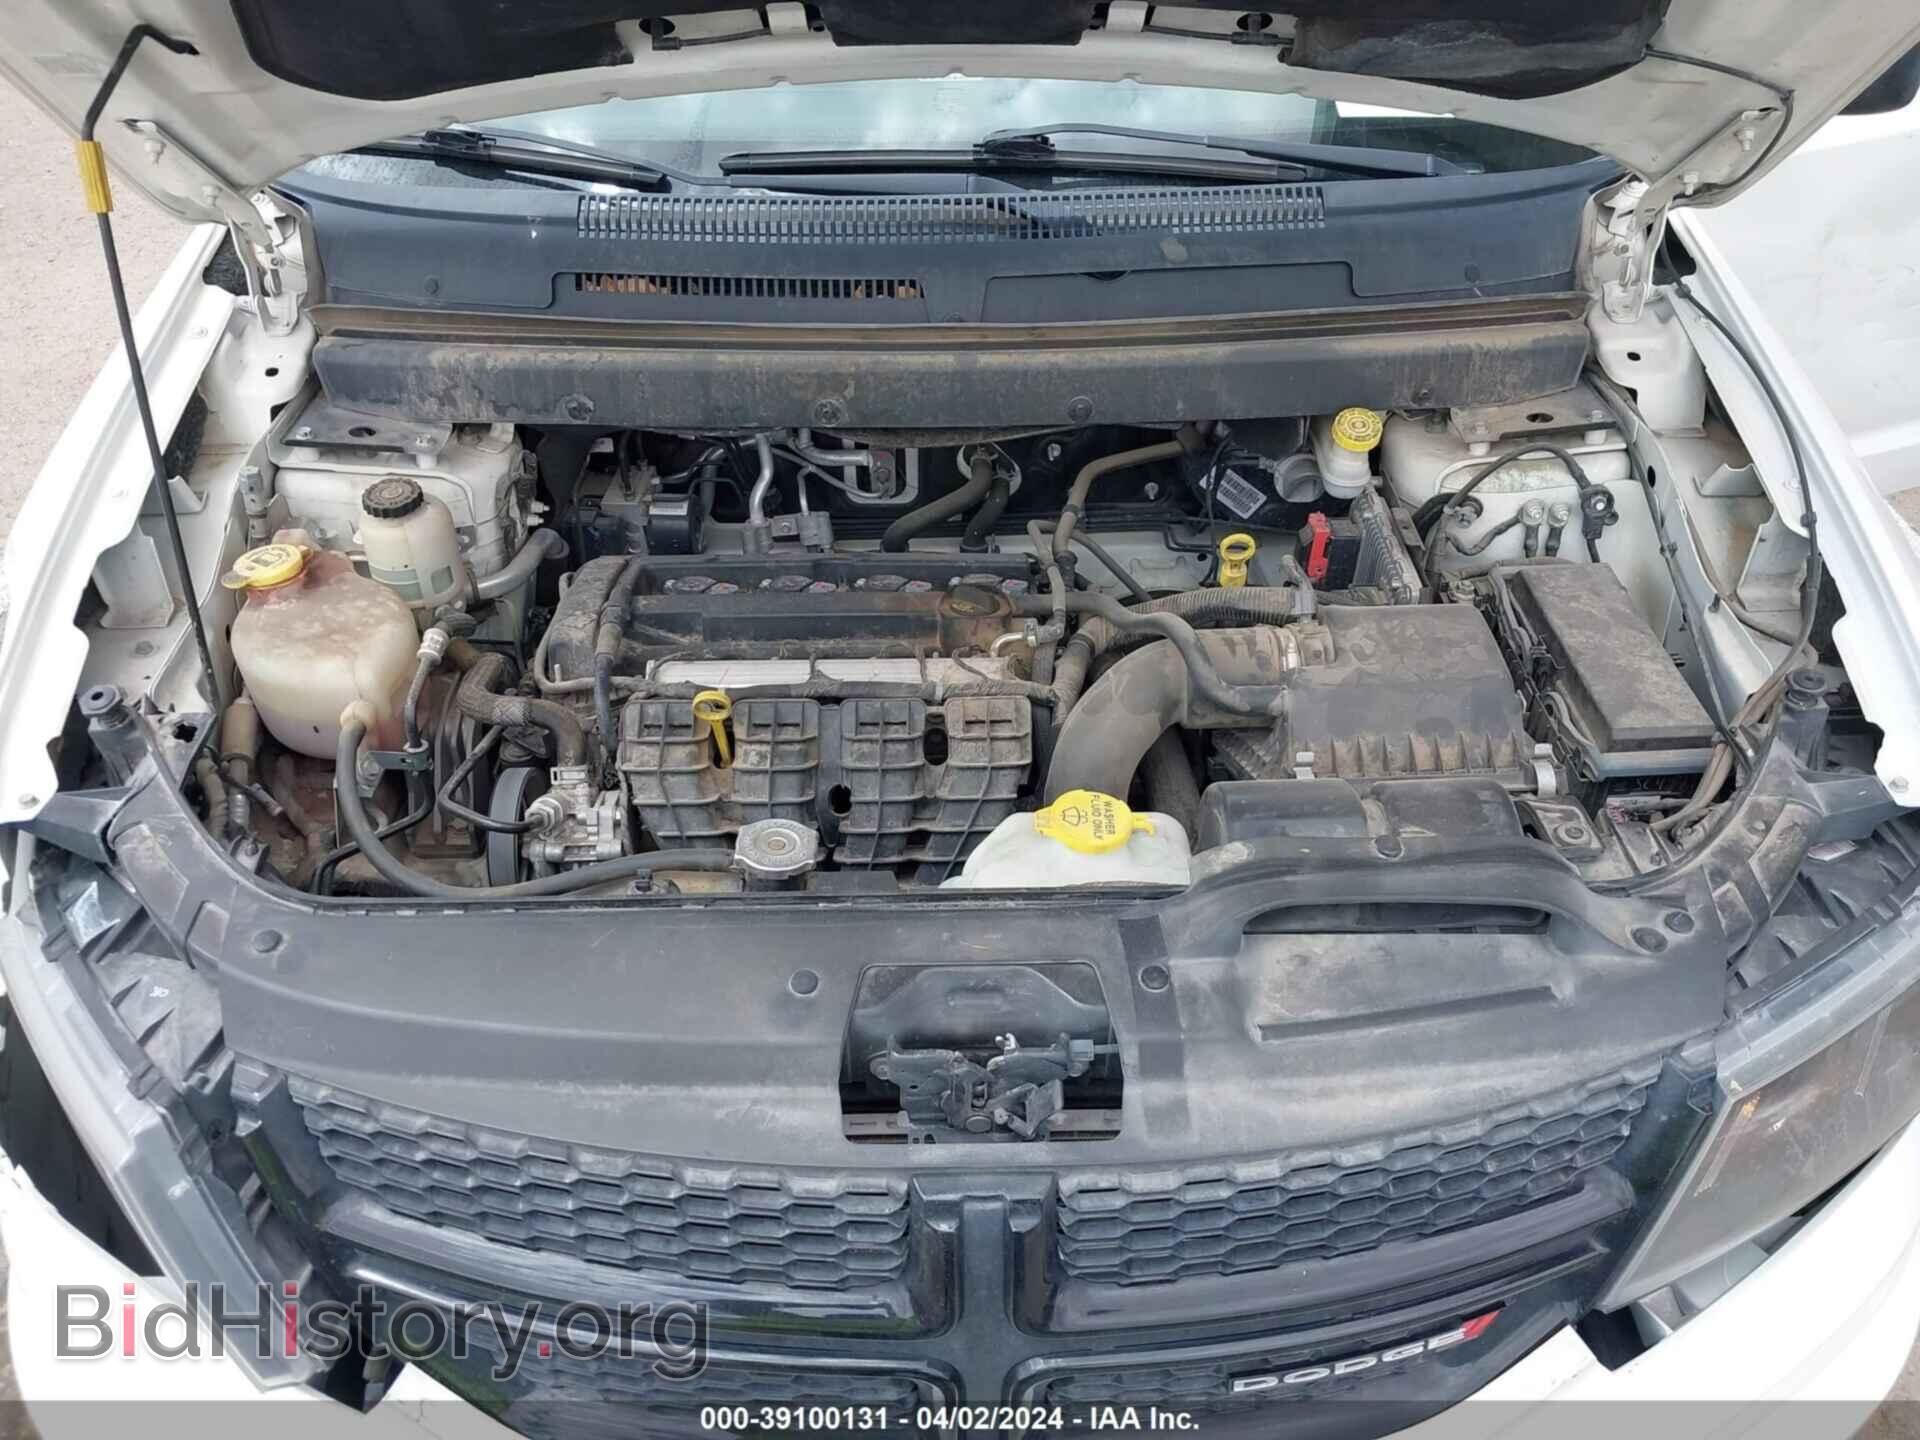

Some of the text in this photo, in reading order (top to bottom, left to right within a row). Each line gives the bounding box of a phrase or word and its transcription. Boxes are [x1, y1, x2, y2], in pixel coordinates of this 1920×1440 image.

[1091, 794, 1104, 841] FLUID ONLY
[1103, 801, 1116, 836] WASHER
[1232, 1327, 1468, 1392] DODGE
